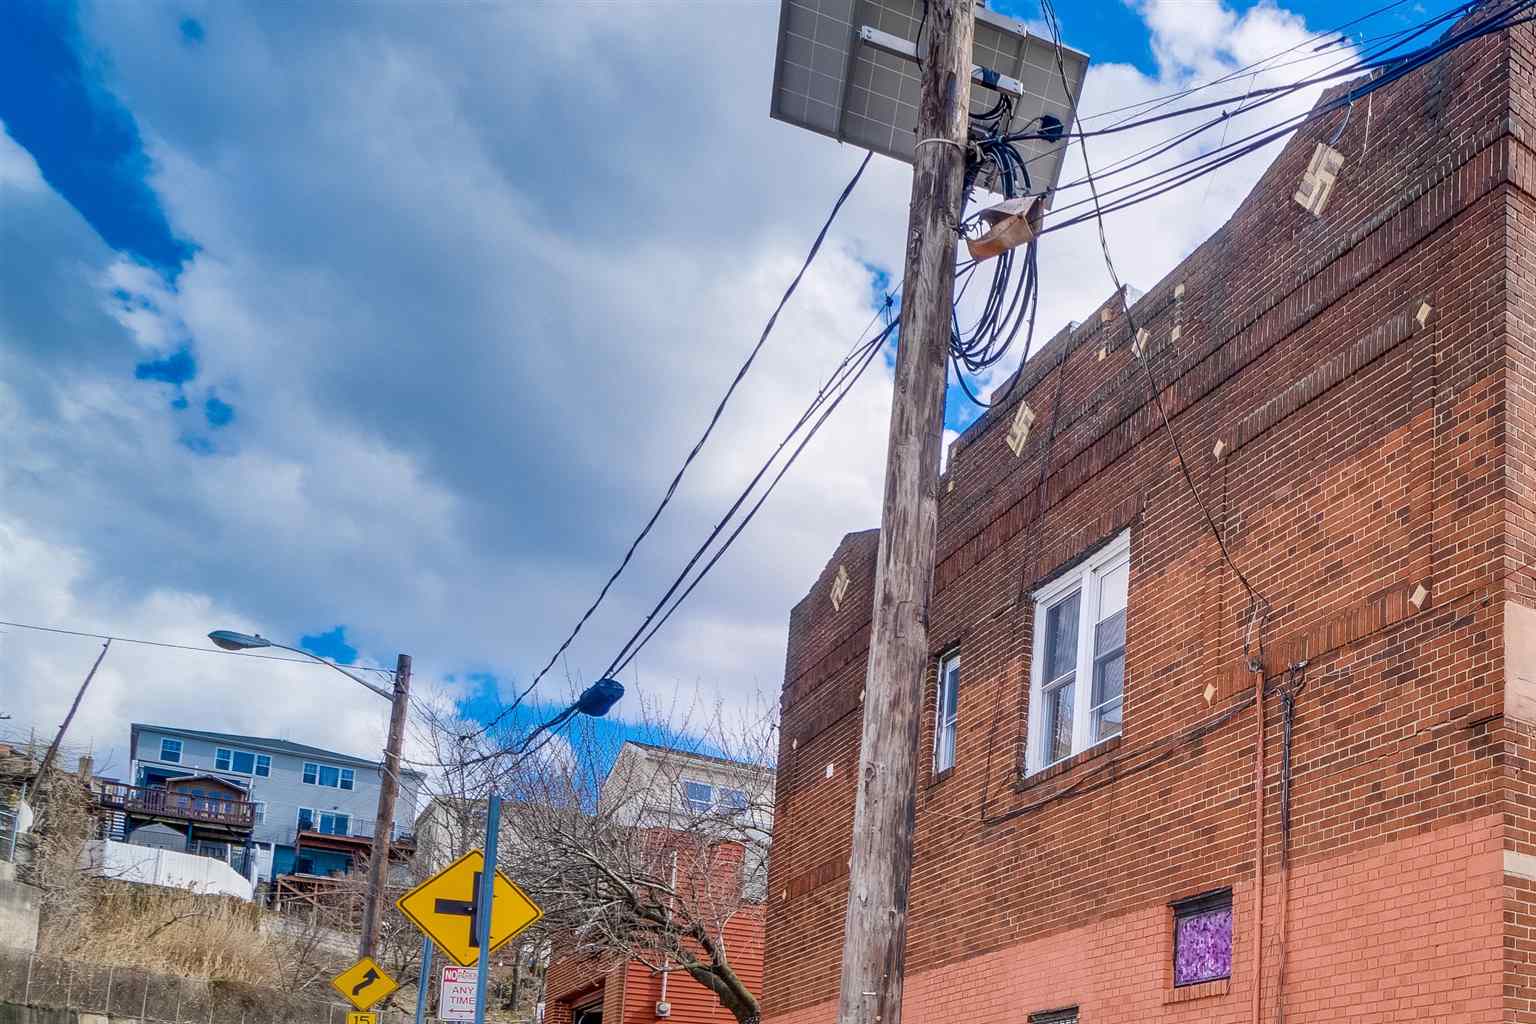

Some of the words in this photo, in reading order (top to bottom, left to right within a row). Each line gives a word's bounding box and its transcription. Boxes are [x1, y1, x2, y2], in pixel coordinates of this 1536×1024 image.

[445, 969, 458, 980] NO
[452, 986, 474, 994] ANY
[450, 996, 475, 1005] TIME
